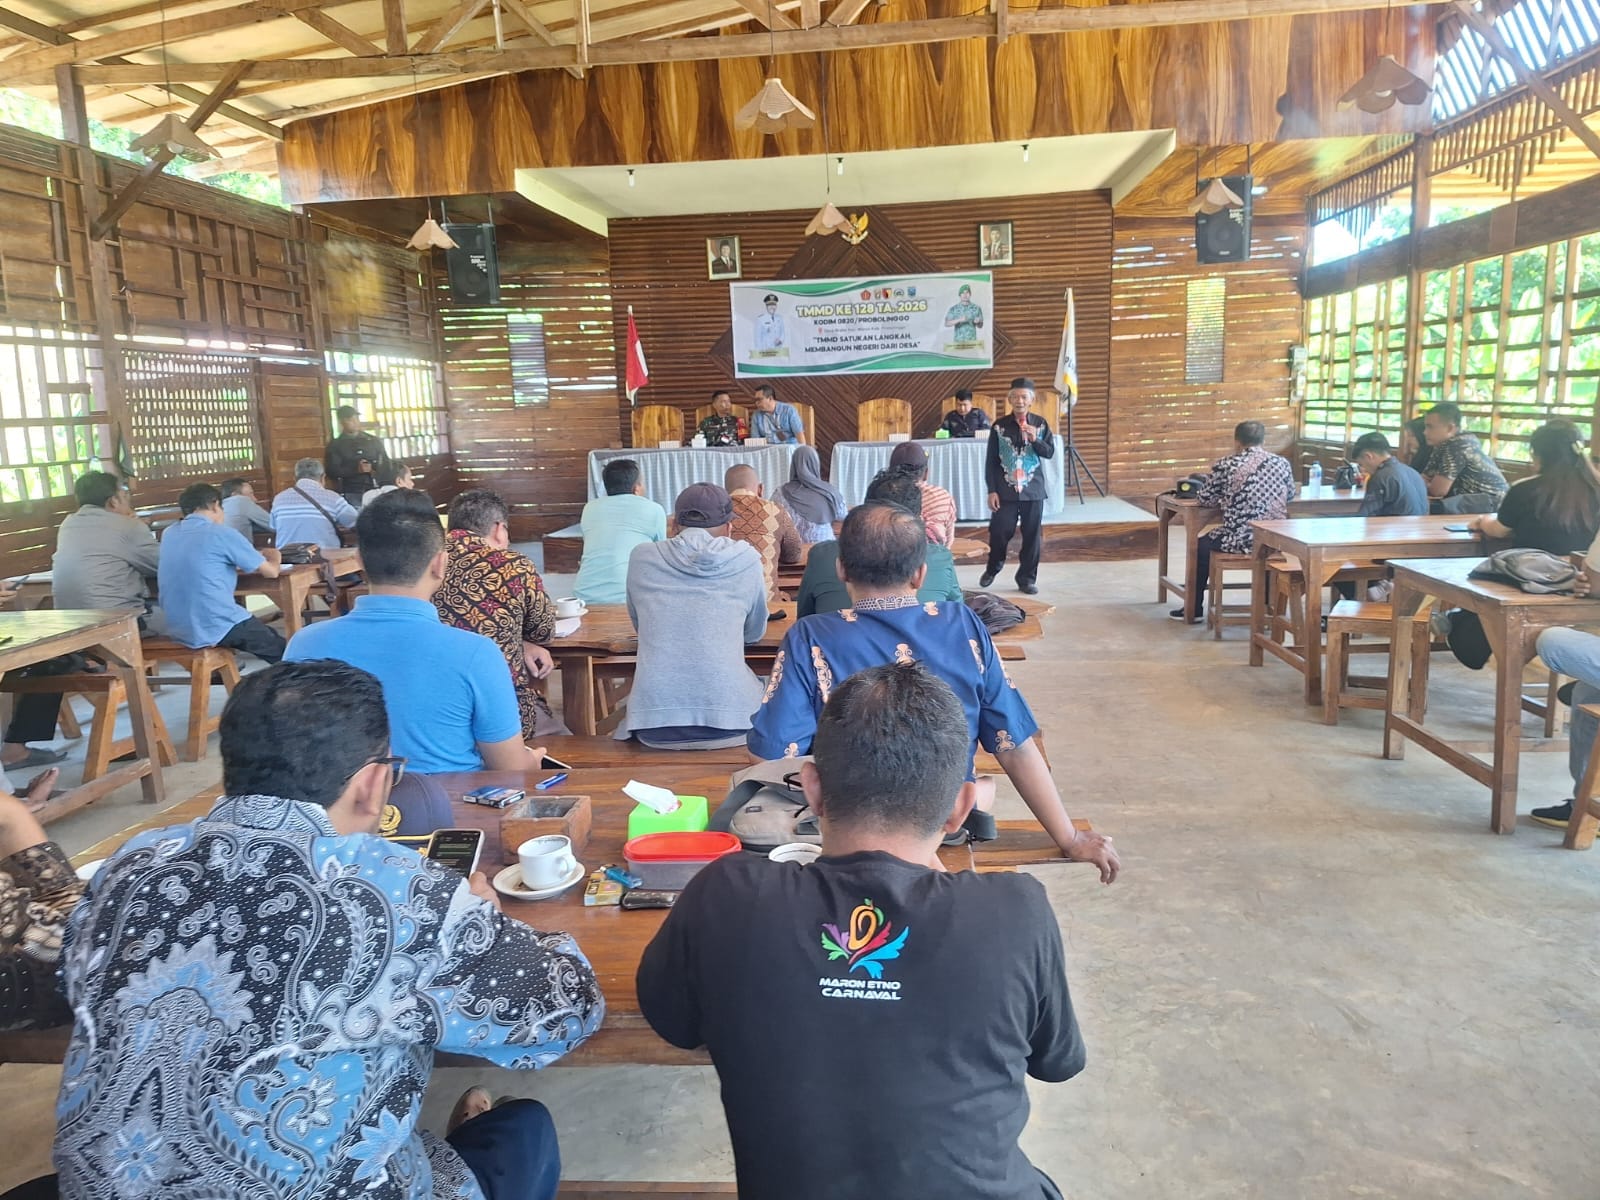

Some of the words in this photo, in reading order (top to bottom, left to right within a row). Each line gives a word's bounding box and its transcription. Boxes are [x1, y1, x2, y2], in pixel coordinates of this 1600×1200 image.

[796, 305, 833, 317] TMMD
[835, 304, 852, 315] KE
[854, 303, 874, 314] 128
[876, 302, 895, 314] TA.
[896, 301, 928, 313] 2026
[839, 335, 873, 343] SATUKAN
[804, 345, 852, 353] MEMBANGUN
[880, 342, 898, 350] DARI
[818, 977, 866, 989] MARON
[867, 979, 901, 990] ETNO
[821, 987, 902, 1000] CARNAVAL
